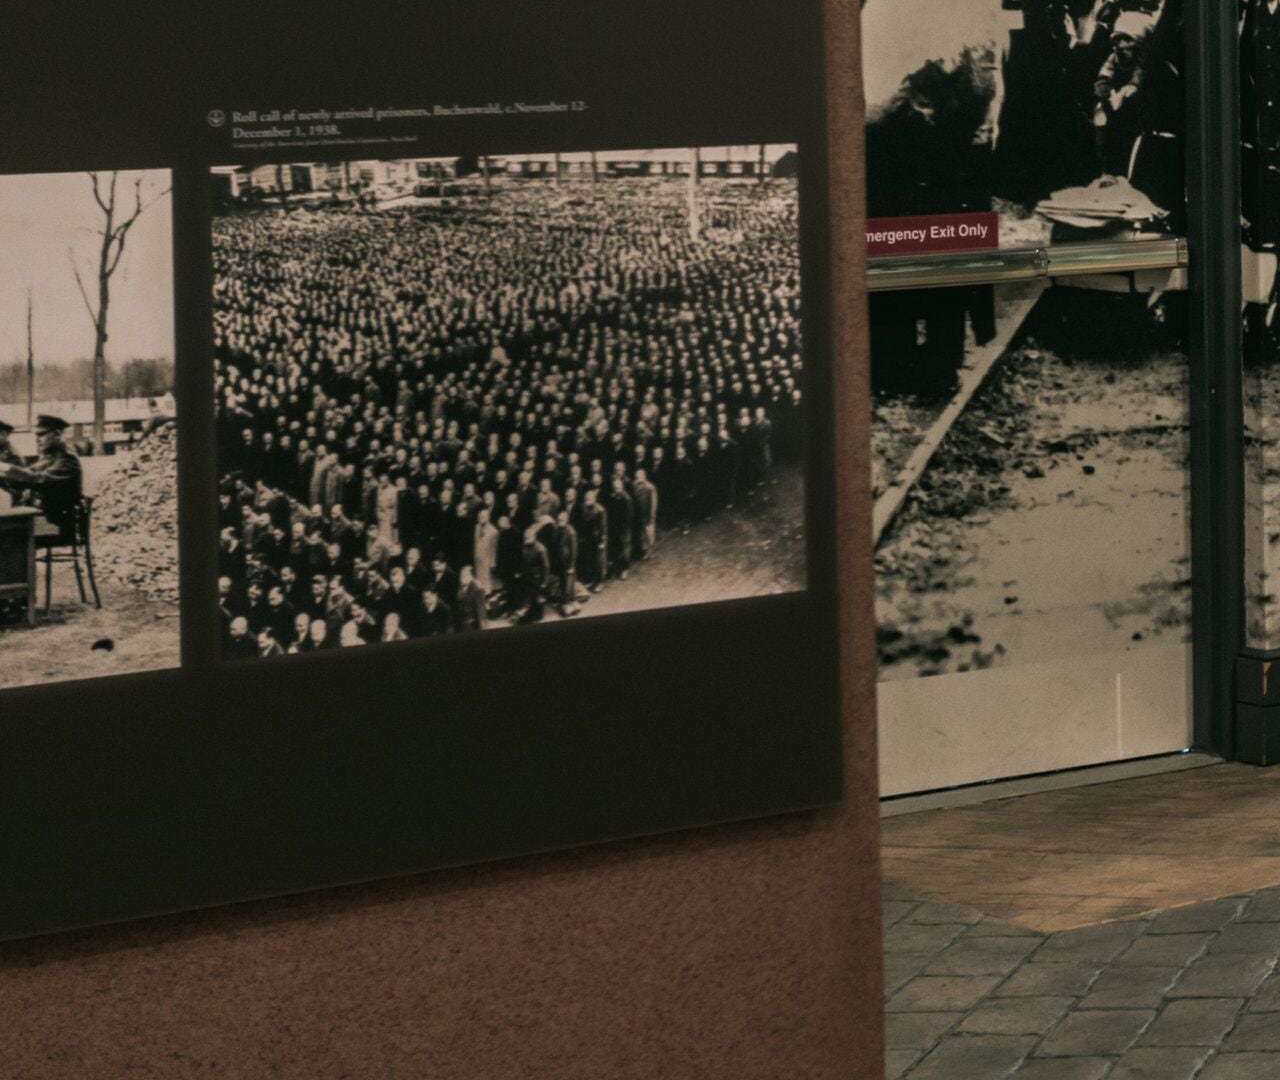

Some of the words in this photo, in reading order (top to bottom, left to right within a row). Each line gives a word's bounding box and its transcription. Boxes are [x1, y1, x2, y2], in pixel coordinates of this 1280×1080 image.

[233, 110, 257, 122] Roll
[259, 110, 280, 121] call
[282, 109, 295, 120] of
[298, 110, 331, 121] newly
[333, 109, 373, 119] arrived
[375, 107, 430, 119] prisoners,
[433, 103, 503, 116] Buchenwald,
[233, 126, 291, 138] December
[294, 125, 306, 136] 1,
[308, 124, 341, 136] 1938.
[866, 229, 926, 244] mergency
[930, 225, 955, 239] Exit
[958, 224, 988, 239] Only
